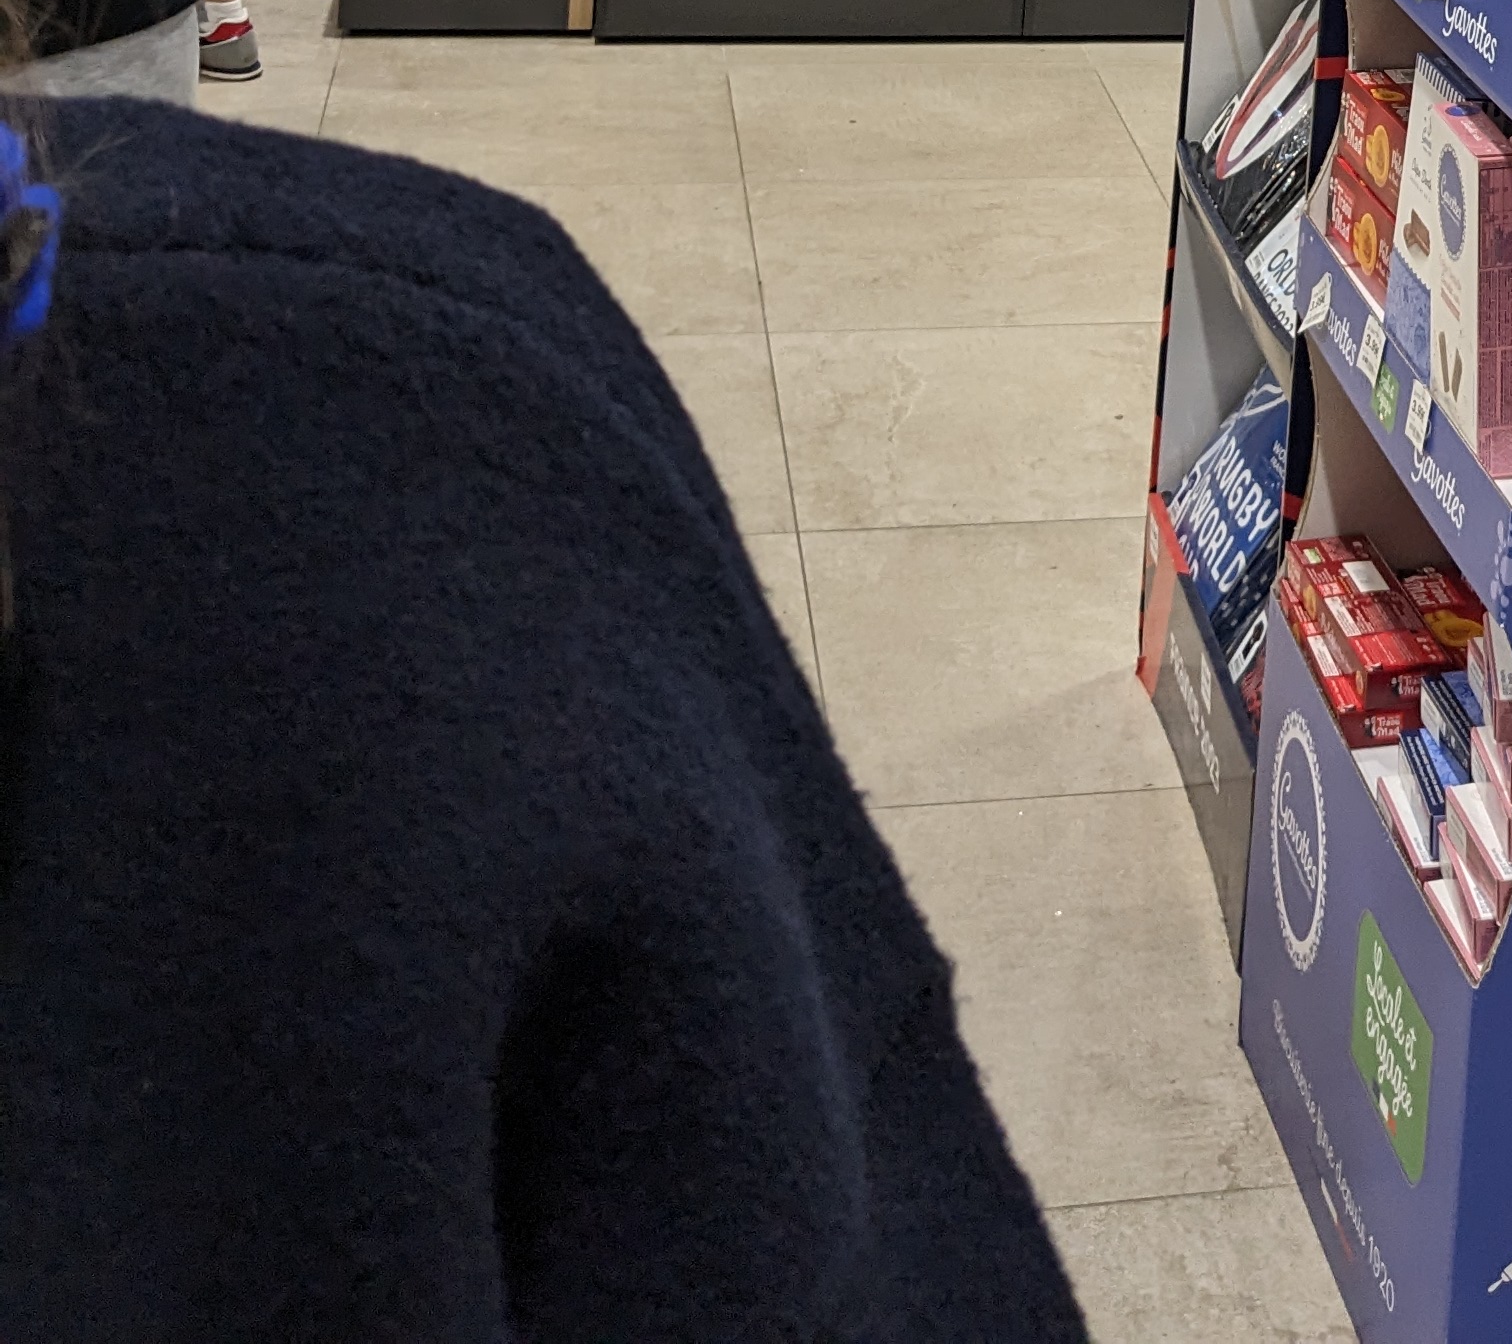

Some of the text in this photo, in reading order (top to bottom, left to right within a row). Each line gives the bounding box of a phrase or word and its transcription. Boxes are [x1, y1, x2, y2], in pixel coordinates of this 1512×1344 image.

[1189, 489, 1246, 593] WORLD
[1214, 436, 1279, 542] RUGBY
[1278, 772, 1318, 889] Gavottes
[1366, 940, 1417, 1071] Locale et
[1366, 1005, 1413, 1118] engagée
[1368, 1235, 1394, 1312] 1920
